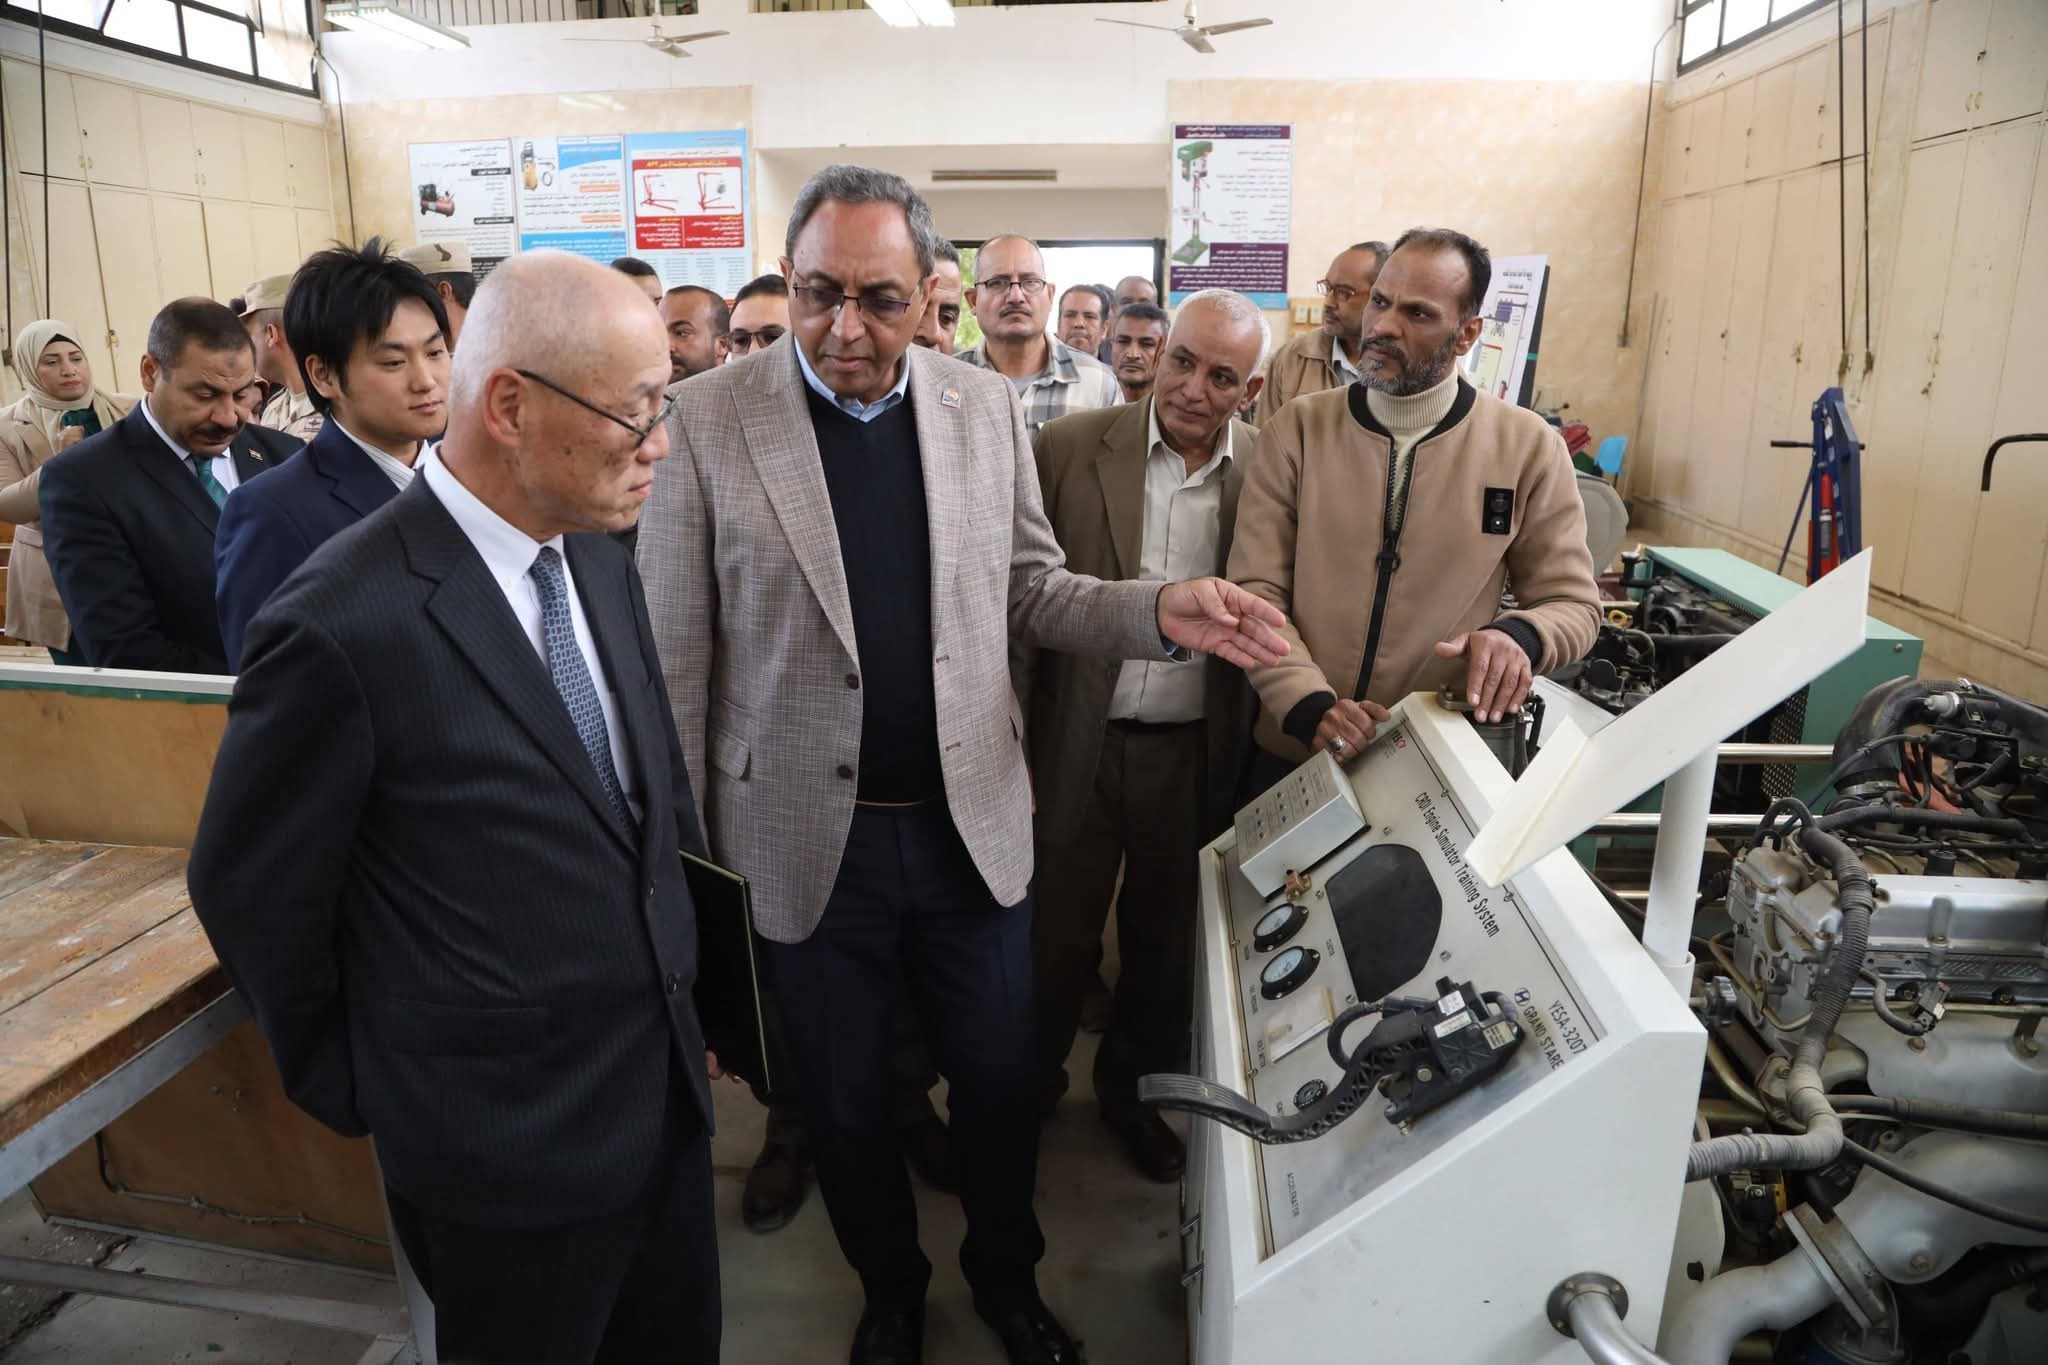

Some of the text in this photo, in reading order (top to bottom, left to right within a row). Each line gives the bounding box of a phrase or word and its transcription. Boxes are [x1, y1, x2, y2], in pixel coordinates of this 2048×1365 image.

[1423, 806, 1441, 833] Engine
[1435, 828, 1460, 867] Simulator
[1454, 864, 1481, 902] Training
[1473, 898, 1500, 937] System
[1523, 1005, 1547, 1037] GRAND
[1549, 1000, 1587, 1054] YESA-3207
